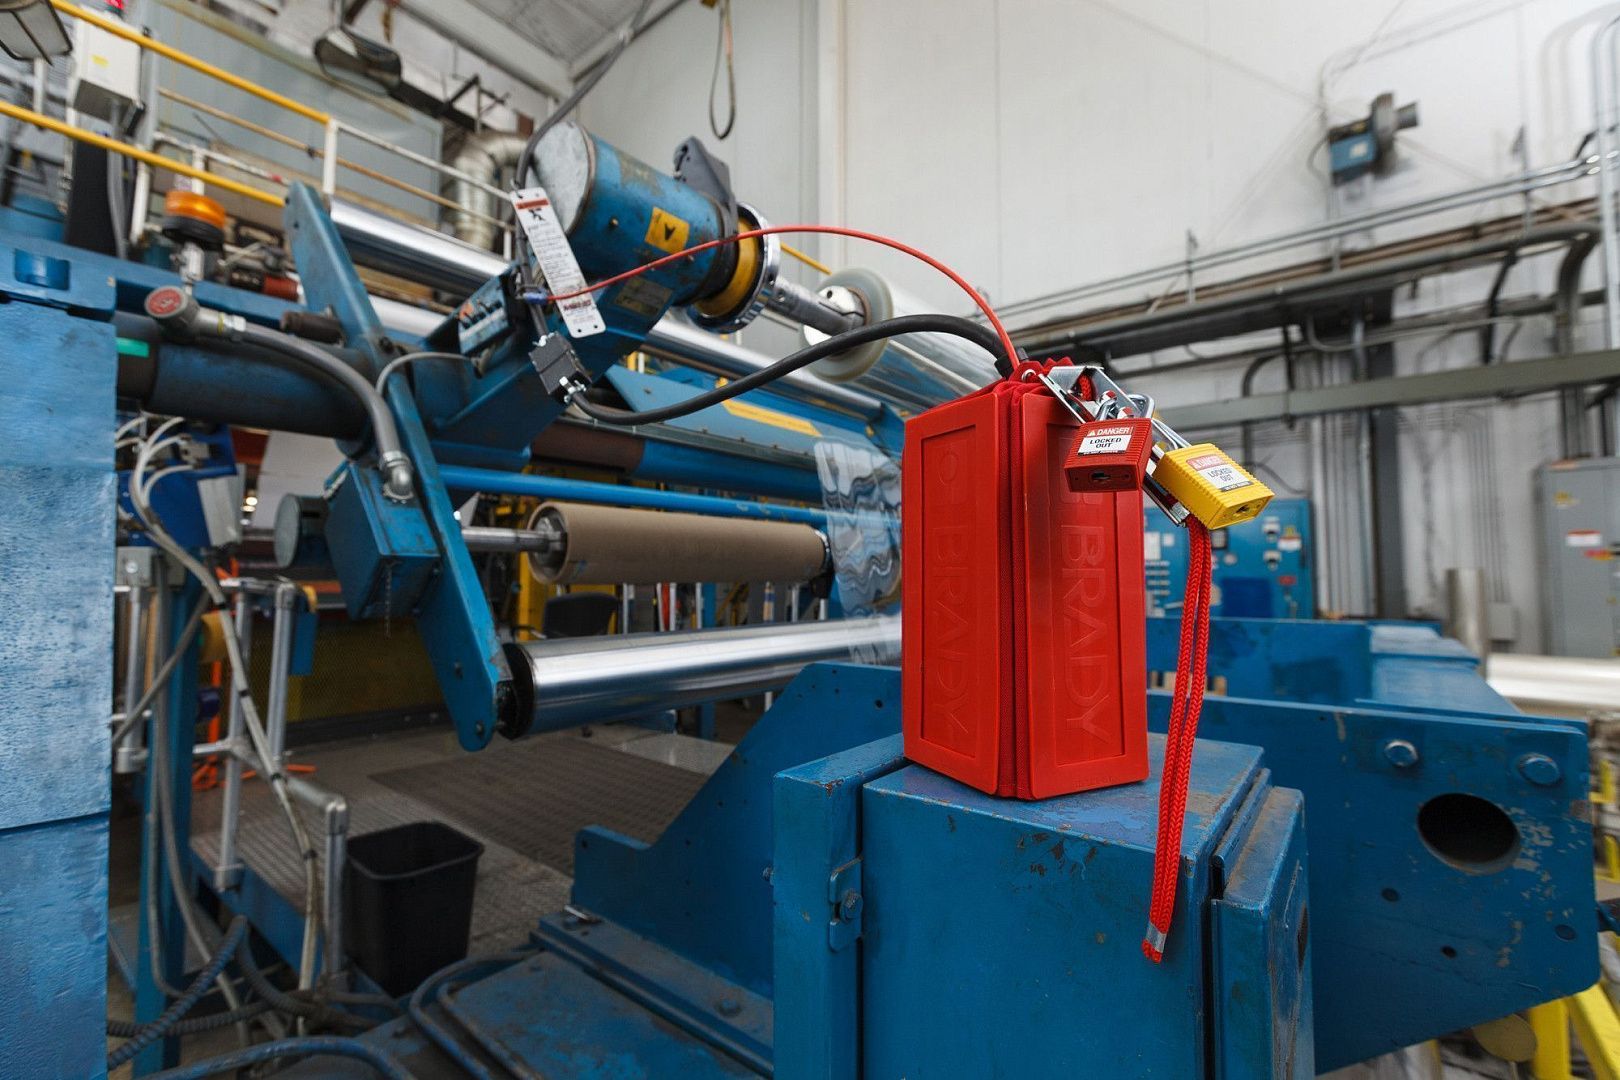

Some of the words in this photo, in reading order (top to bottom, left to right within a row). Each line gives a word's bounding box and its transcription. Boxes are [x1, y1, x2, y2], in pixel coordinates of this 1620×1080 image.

[1096, 427, 1130, 436] DANGER
[1089, 437, 1122, 445] LOCKED
[1207, 467, 1233, 478] LOCKED
[1219, 473, 1234, 482] OUT
[931, 525, 969, 735] BRADY
[1060, 524, 1110, 743] BRADY
